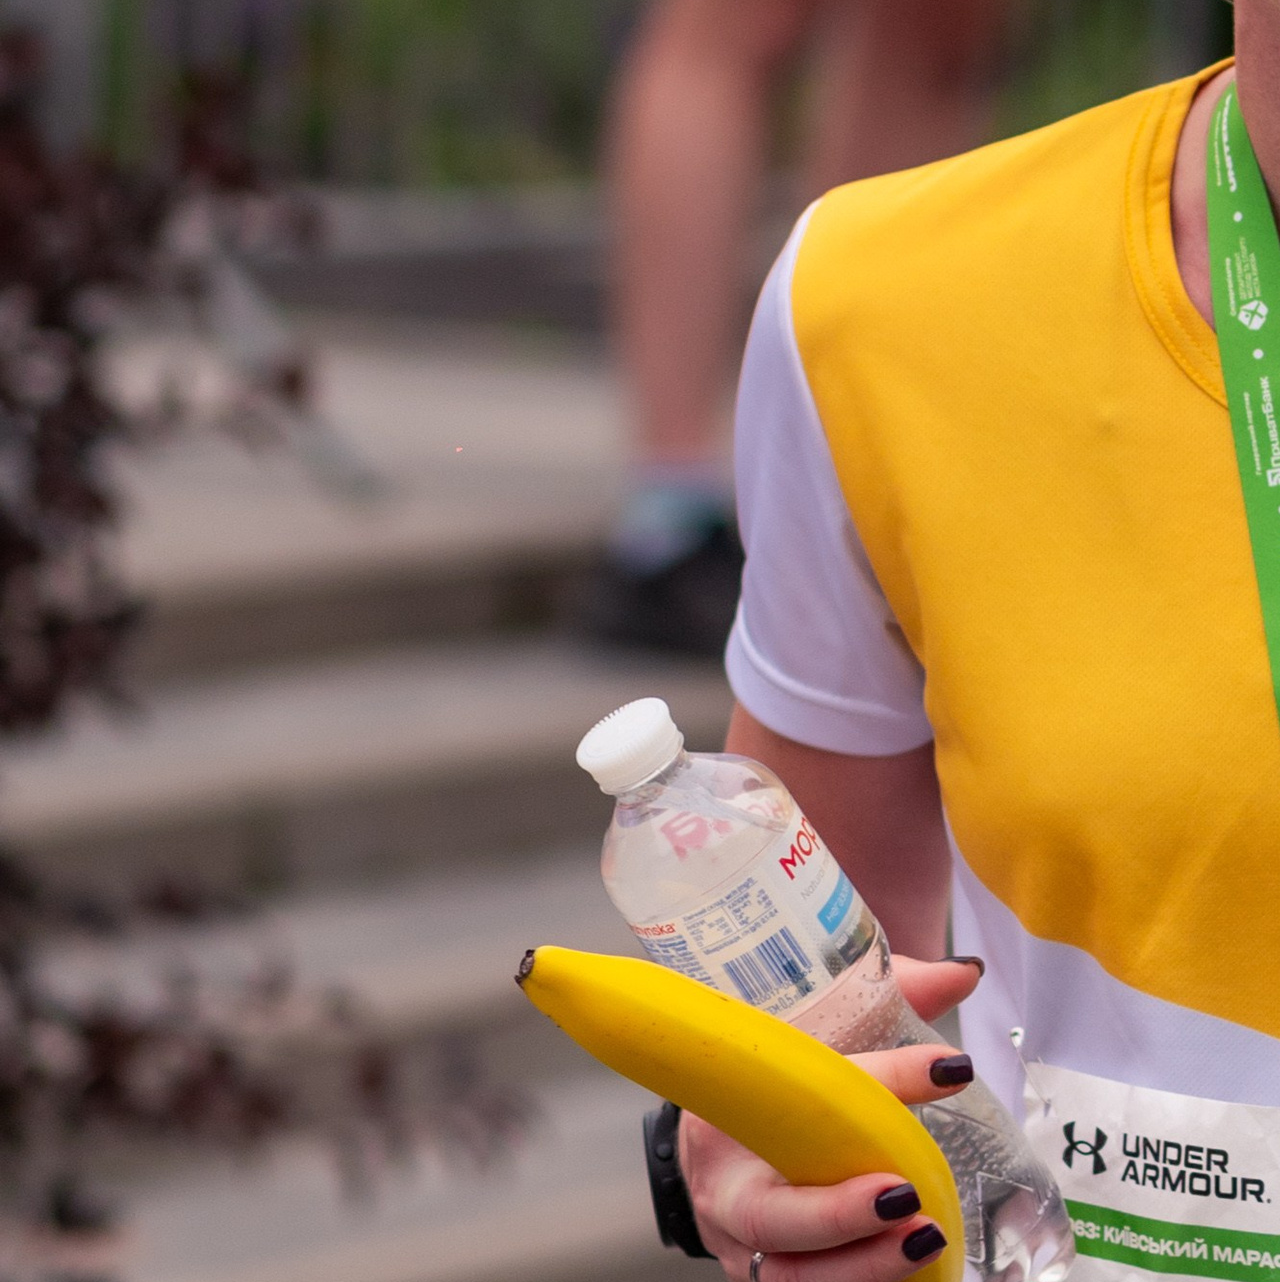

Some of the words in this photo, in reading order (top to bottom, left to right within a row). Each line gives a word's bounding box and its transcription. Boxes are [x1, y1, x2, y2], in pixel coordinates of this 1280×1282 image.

[1121, 1133, 1229, 1174] UNDER
[1069, 1219, 1100, 1242] 63:
[1103, 1223, 1208, 1259] КИЇВСЬКИЙ
